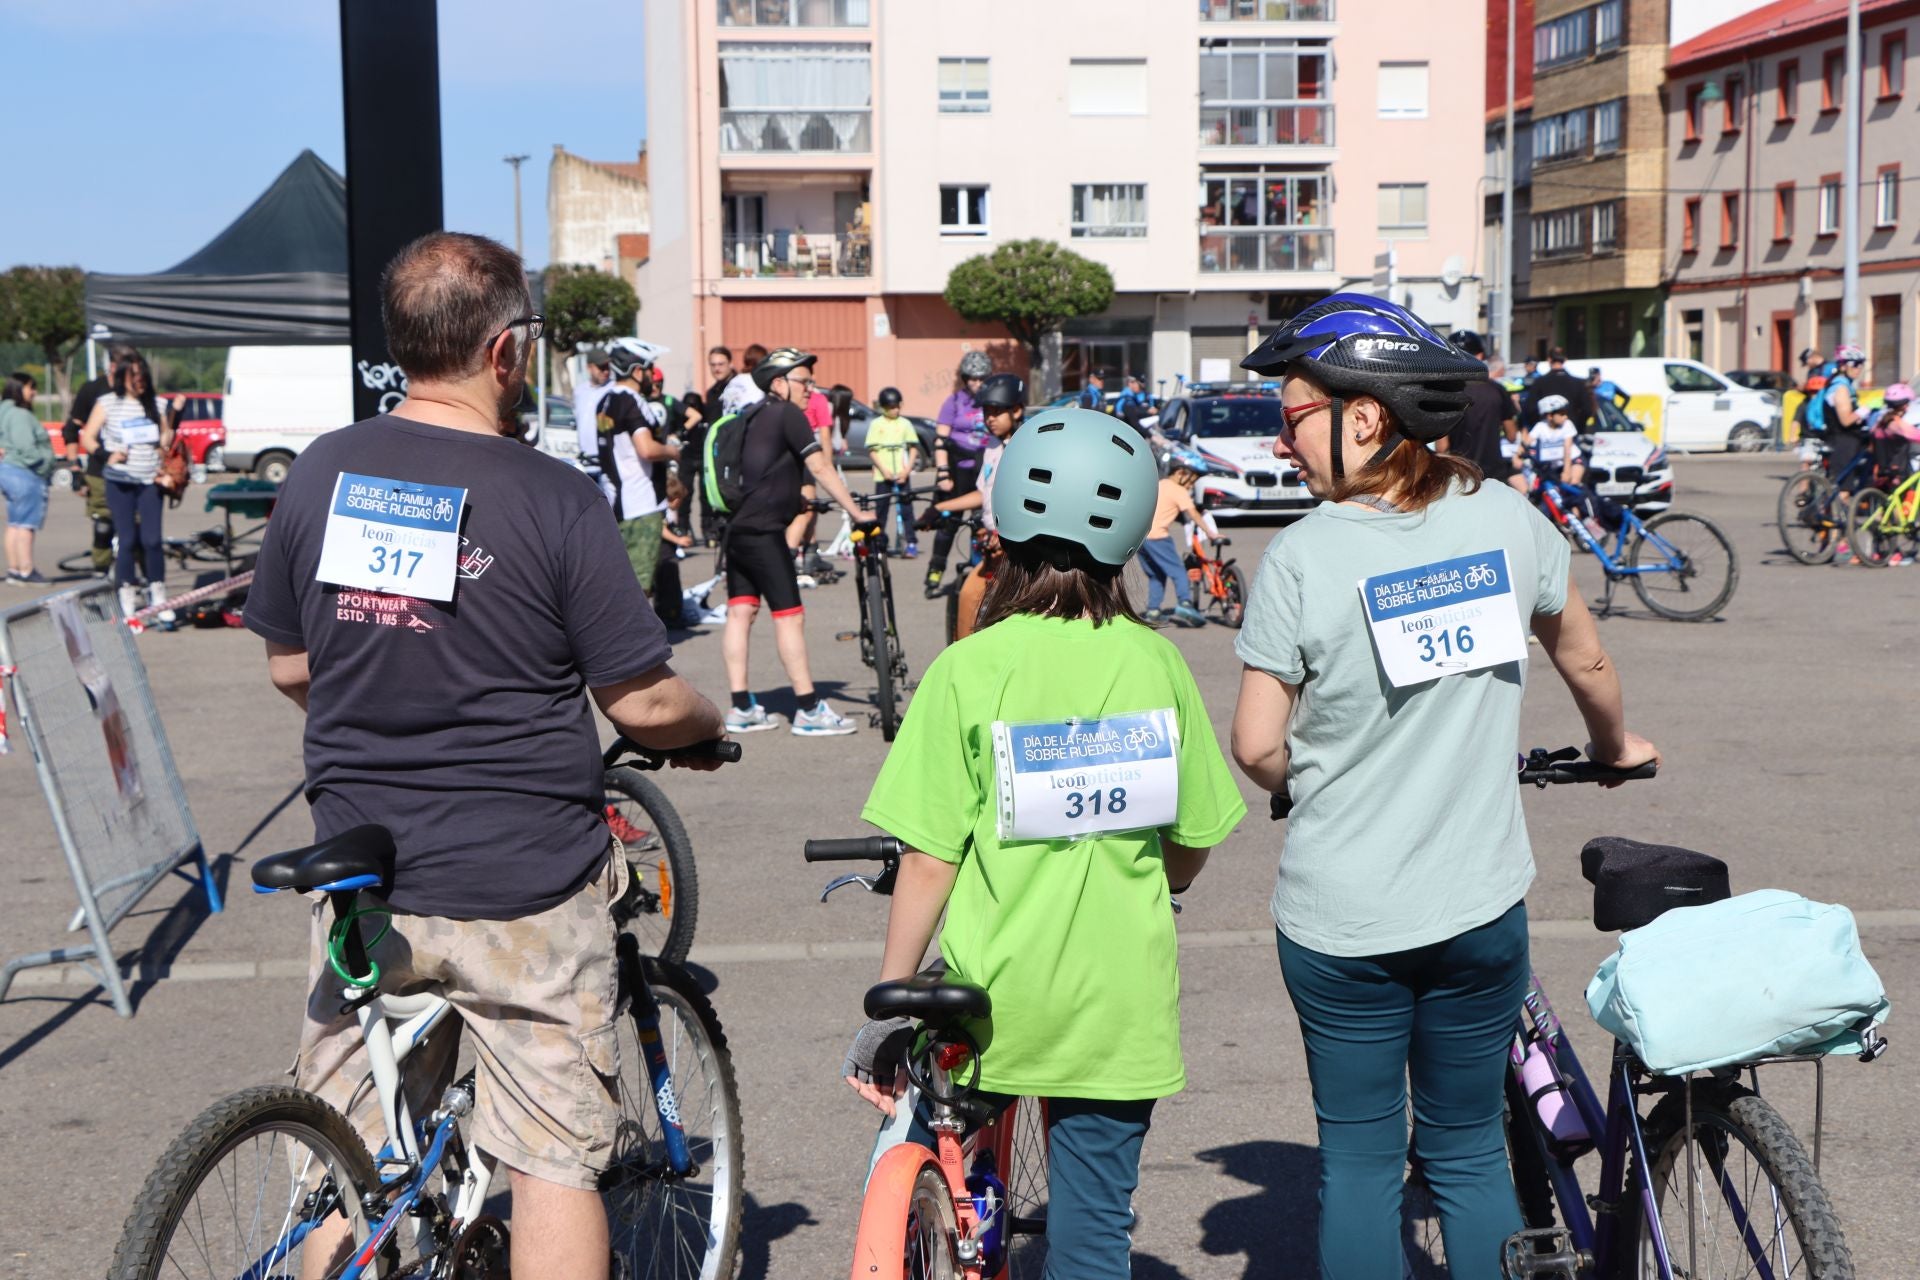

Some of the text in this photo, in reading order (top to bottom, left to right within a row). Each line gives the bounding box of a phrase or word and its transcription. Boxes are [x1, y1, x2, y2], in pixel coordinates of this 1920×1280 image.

[1376, 339, 1420, 352] Terzo
[349, 483, 434, 507] DÍA DE LA FAMILIA
[346, 495, 432, 520] SOBRE RUEDAS
[368, 545, 424, 578] 317
[1374, 569, 1461, 598] DÍA DE LA FAMILIA
[337, 593, 408, 611] SPORTWEAR
[1376, 581, 1463, 611] SOBRE RUEDAS
[336, 608, 369, 624] ESTD.
[1417, 625, 1475, 663] 316
[1023, 730, 1120, 748] DÍA DE LA FAMILIA
[1025, 741, 1122, 762] SOBRE RUEDAS
[1050, 767, 1142, 790] leonoticias
[1065, 787, 1127, 819] 318
